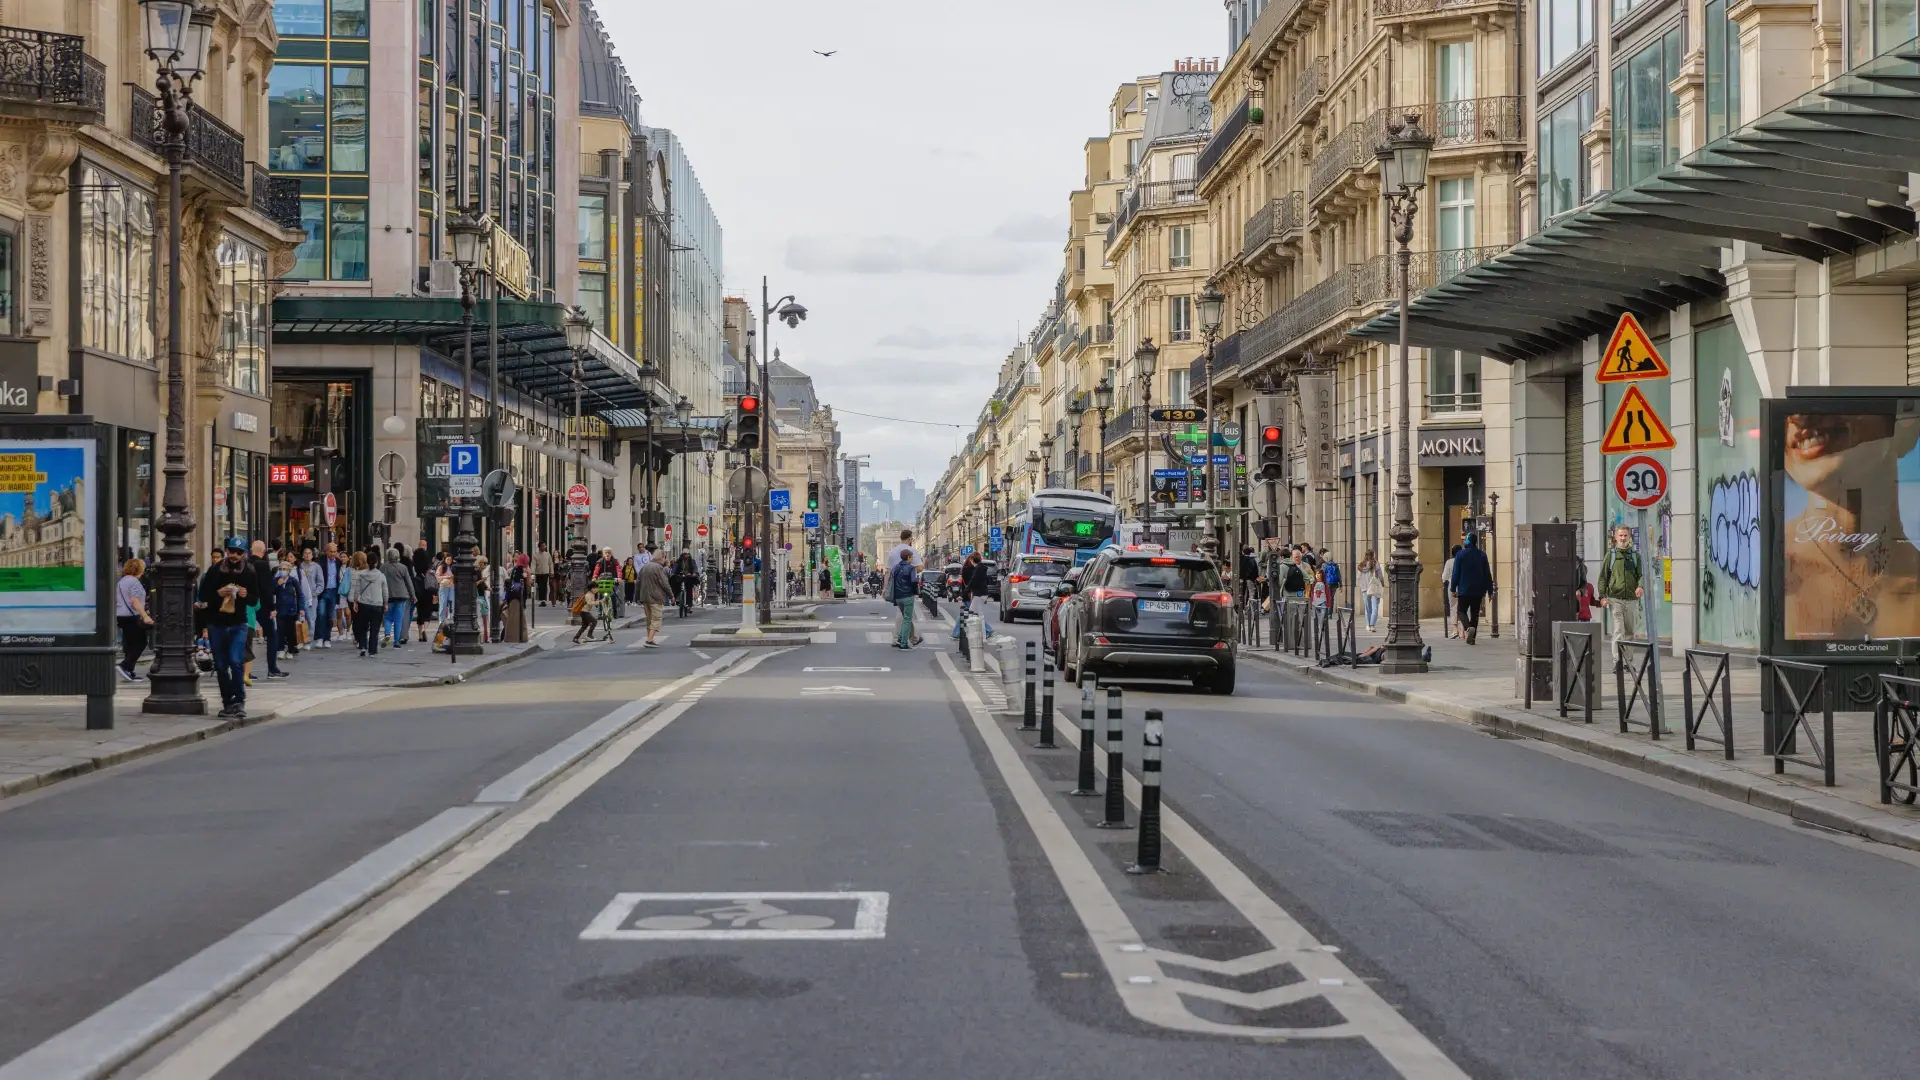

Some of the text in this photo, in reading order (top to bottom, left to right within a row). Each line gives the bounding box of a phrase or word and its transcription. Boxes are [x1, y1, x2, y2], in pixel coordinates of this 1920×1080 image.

[0, 381, 28, 405] ka
[1418, 437, 1483, 455] MONKI
[458, 451, 472, 470] P
[1626, 470, 1658, 492] 30
[1795, 516, 1879, 552] Poiray
[1144, 601, 1182, 610] EP-456-TN
[1837, 643, 1889, 652] Clear Channel
